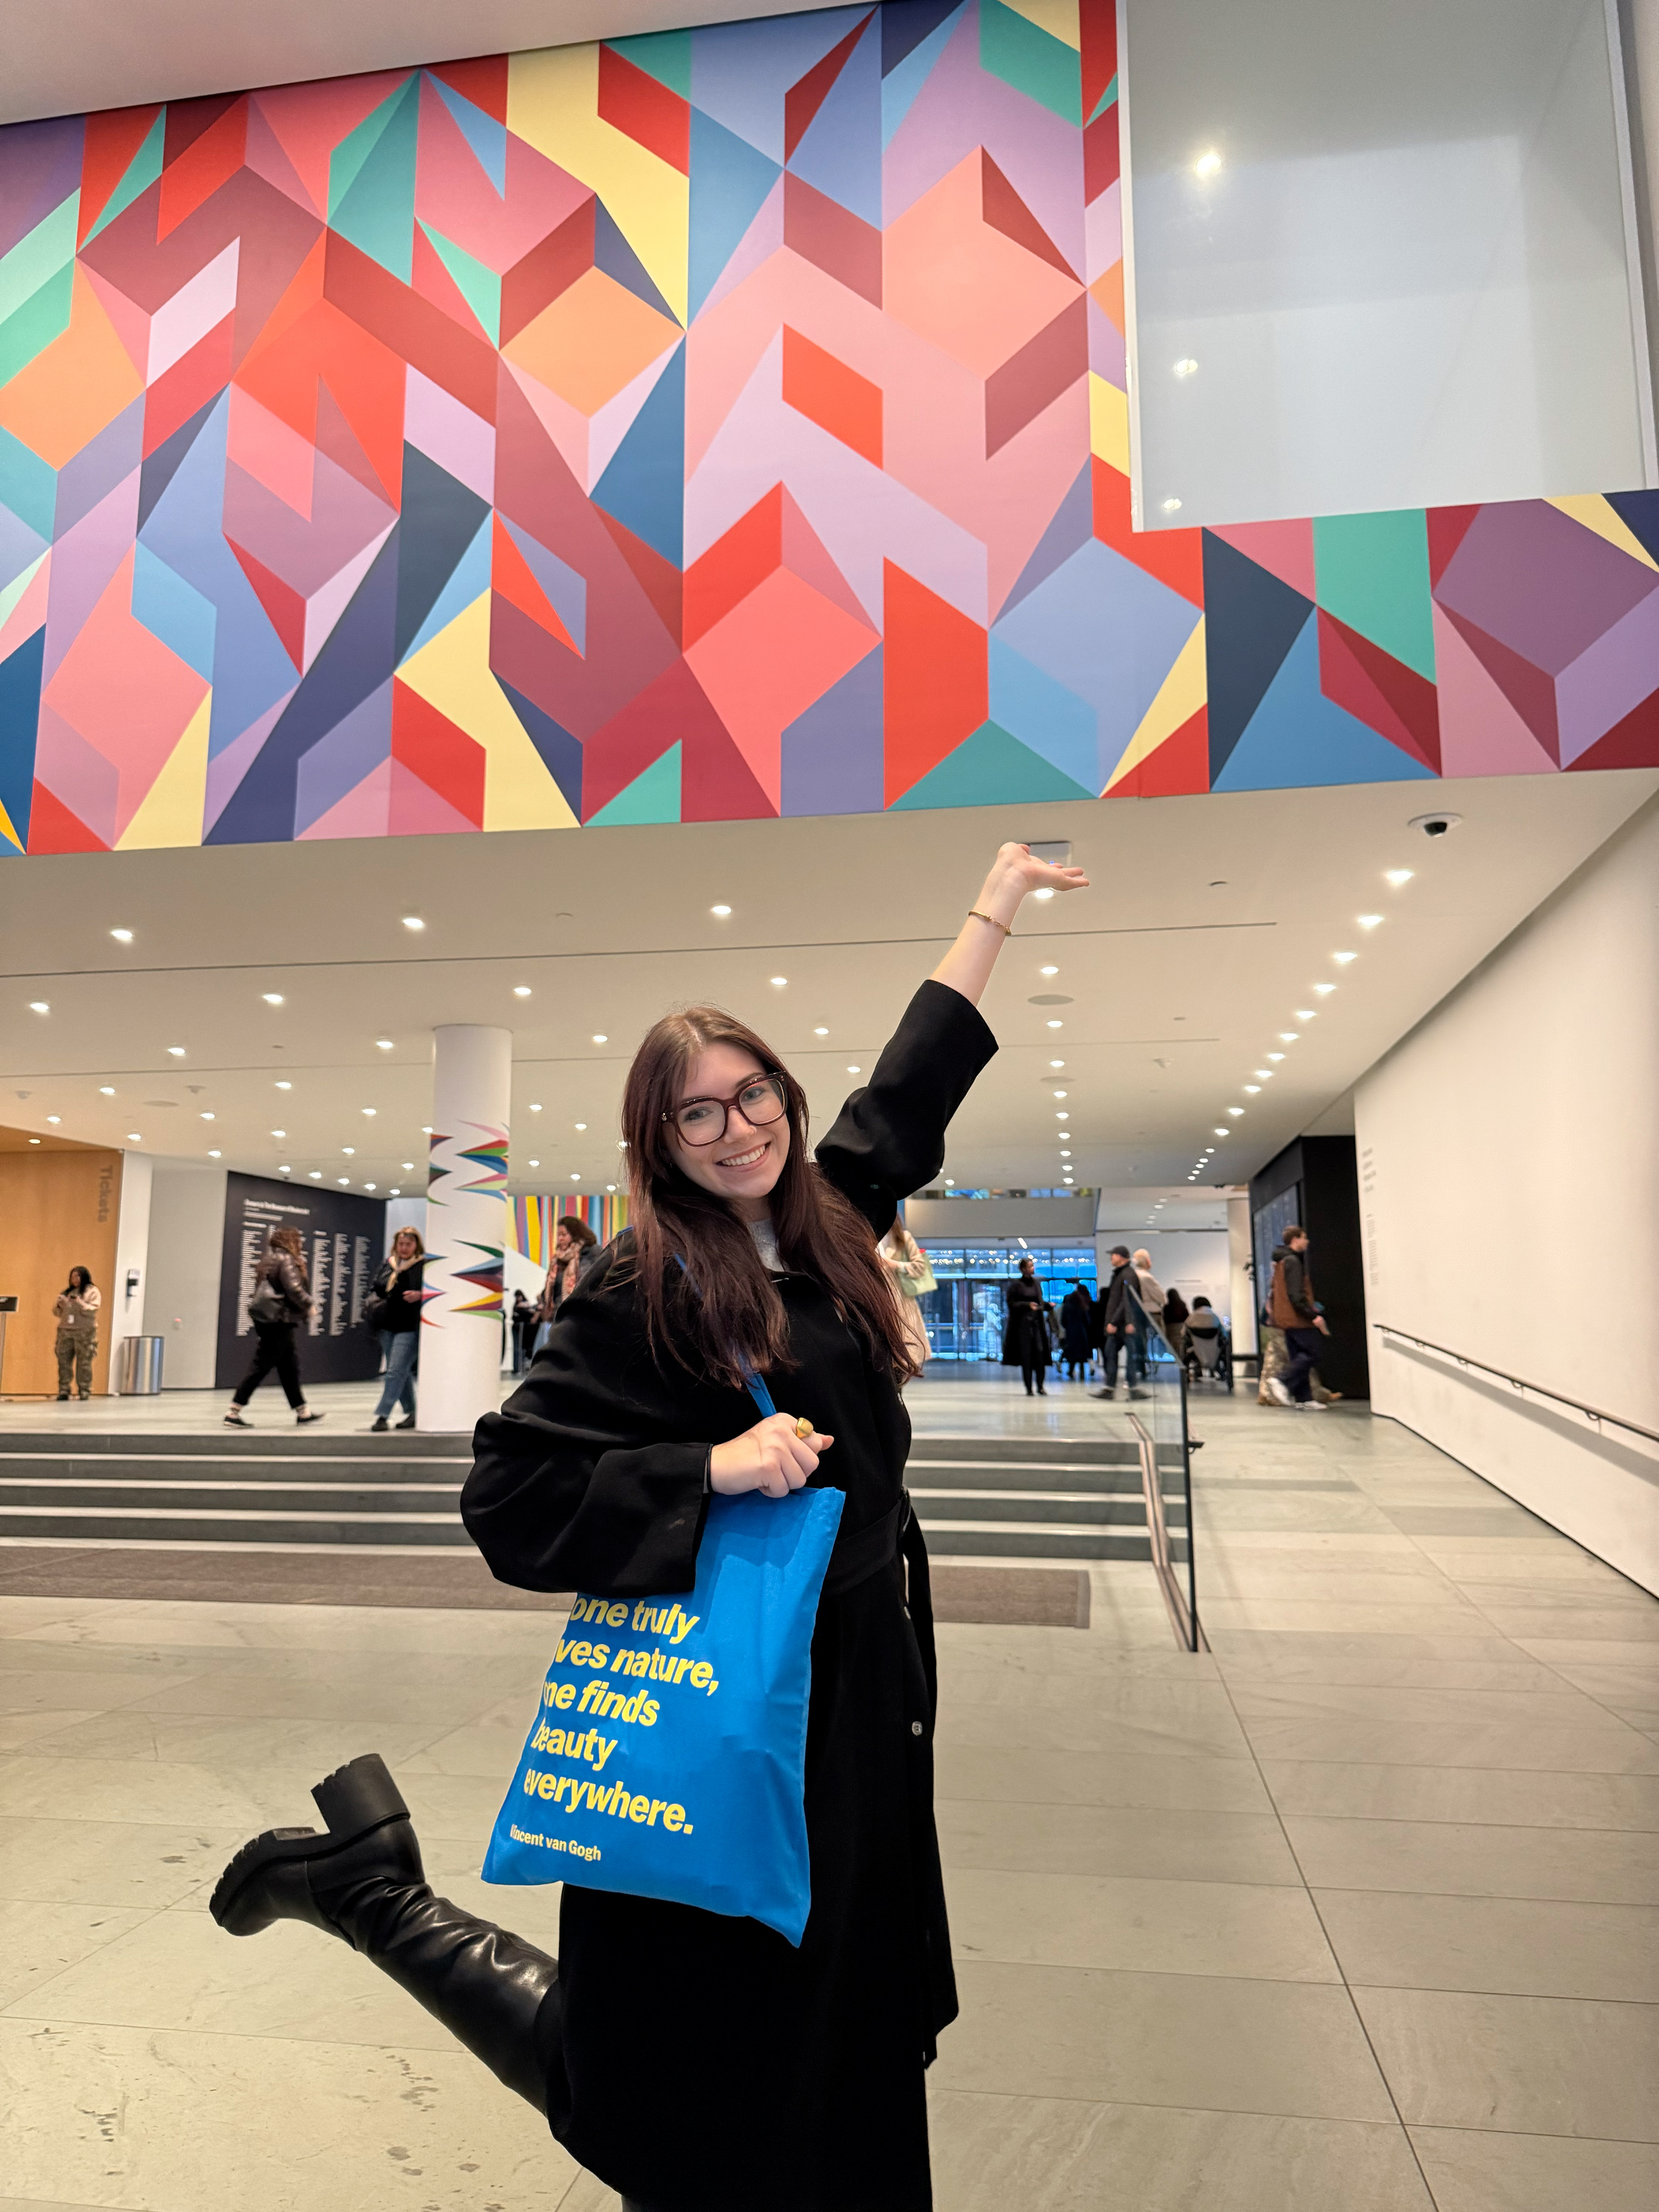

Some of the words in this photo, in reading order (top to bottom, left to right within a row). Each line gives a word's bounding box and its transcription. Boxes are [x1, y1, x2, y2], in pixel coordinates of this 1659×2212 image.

[98, 1165, 113, 1223] Tickets
[569, 1598, 629, 1627] one
[631, 1600, 700, 1644] truly
[610, 1647, 719, 1697] nature,
[576, 1680, 660, 1727] finds
[531, 1717, 618, 1771] beauty
[524, 1768, 694, 1835] everywhere.
[545, 1837, 567, 1853] van
[568, 1840, 601, 1862] Gogh
